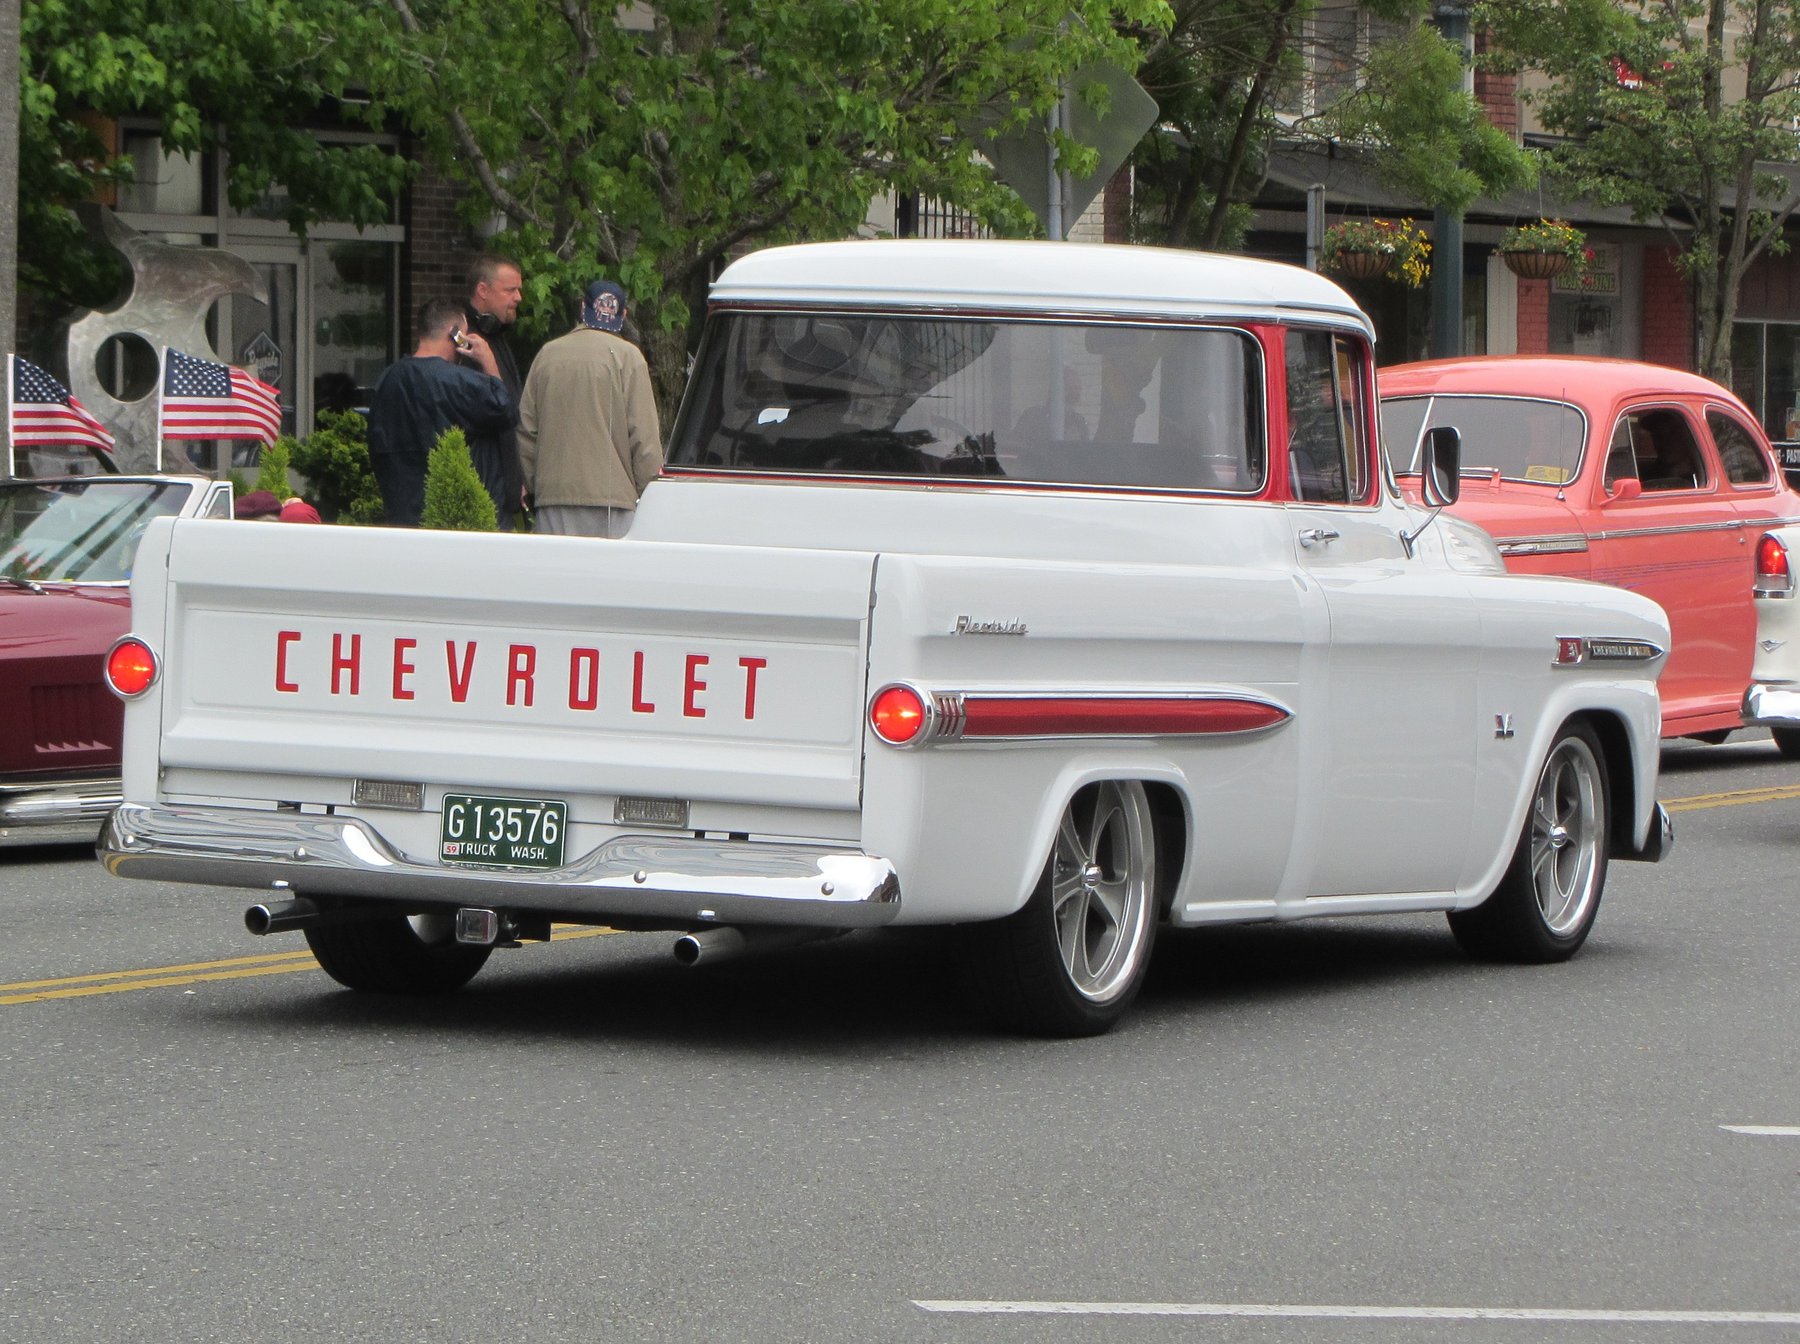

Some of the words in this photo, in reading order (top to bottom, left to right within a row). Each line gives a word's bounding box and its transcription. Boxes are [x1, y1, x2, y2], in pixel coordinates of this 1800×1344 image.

[949, 615, 1029, 635] Fleetside
[275, 631, 768, 720] CHEVROLET
[448, 804, 559, 845] G13576
[446, 845, 457, 854] 59
[459, 842, 497, 857] TRUCK
[510, 845, 549, 860] WASH.
